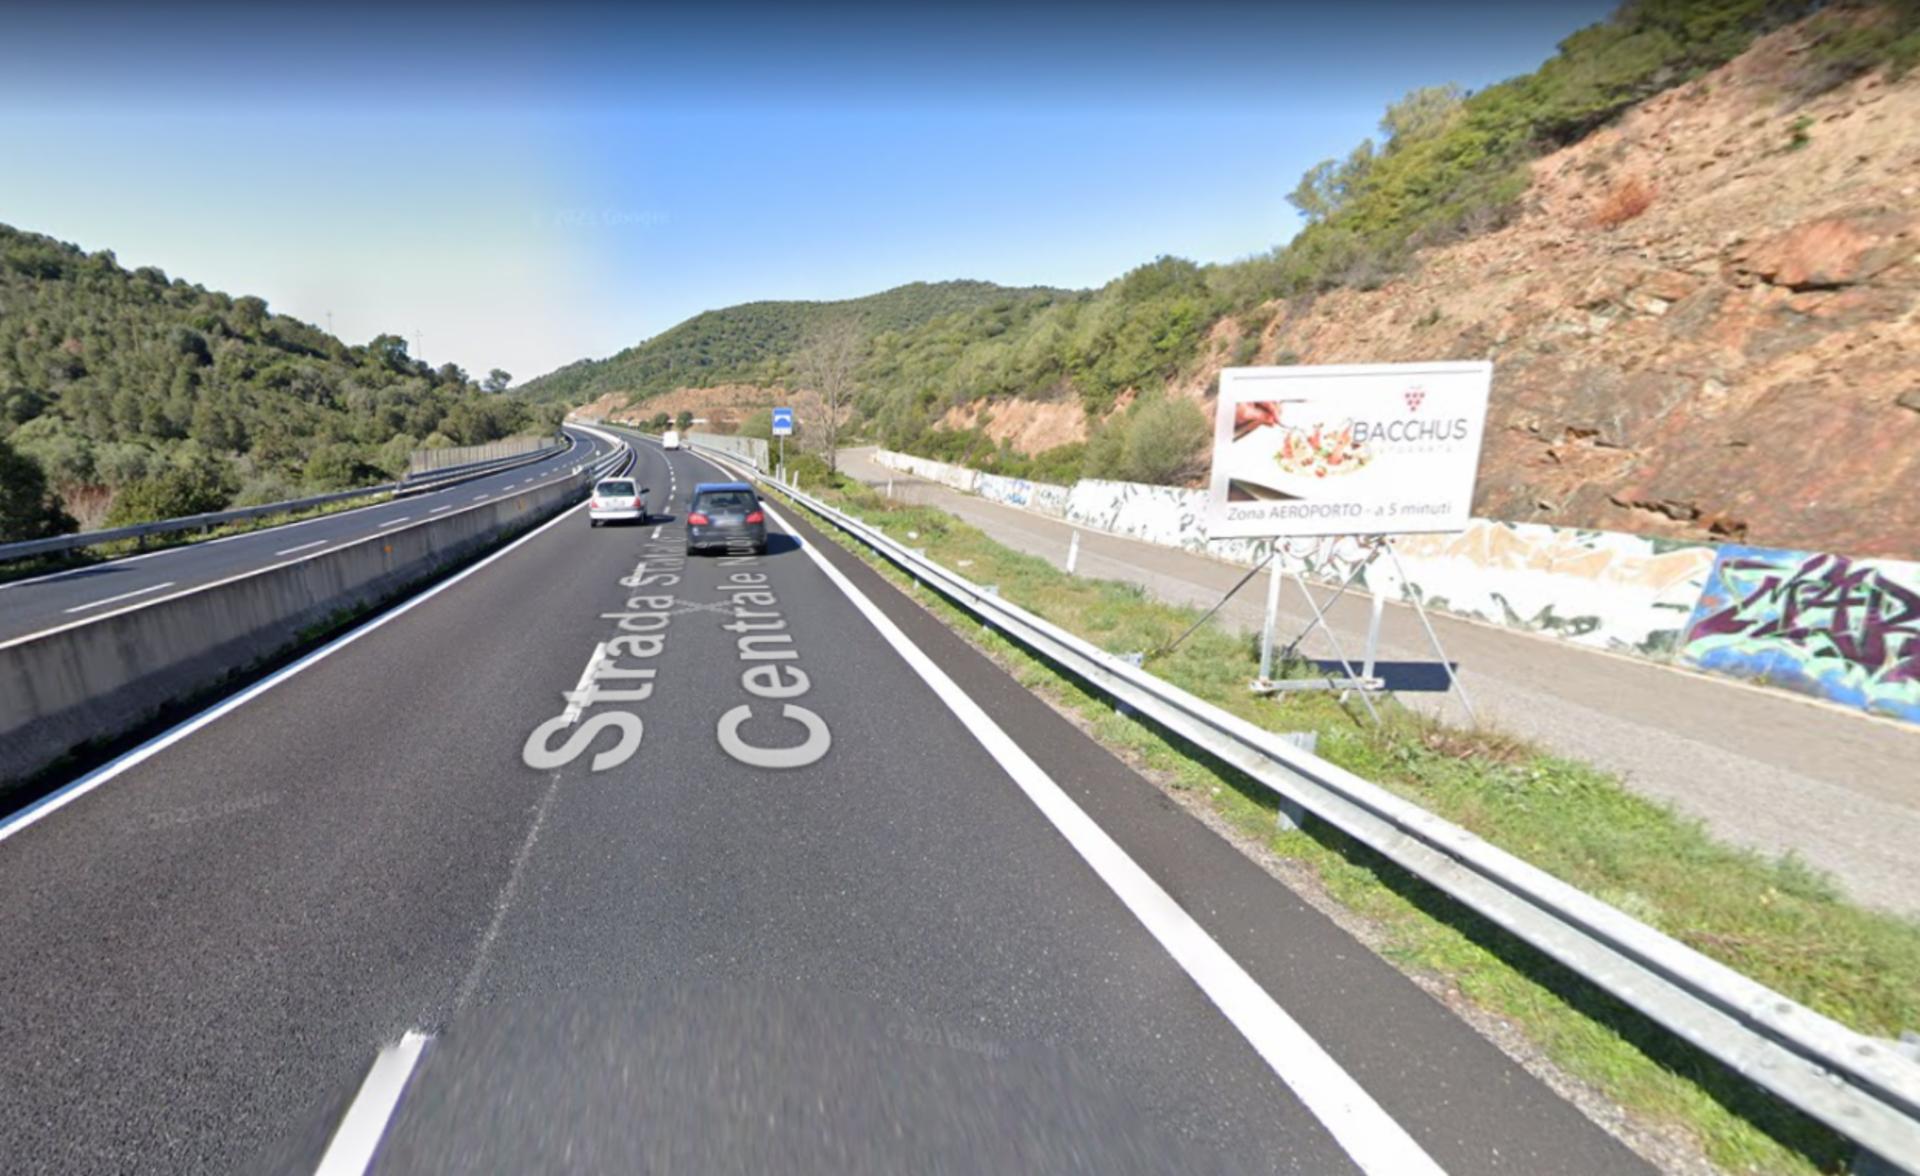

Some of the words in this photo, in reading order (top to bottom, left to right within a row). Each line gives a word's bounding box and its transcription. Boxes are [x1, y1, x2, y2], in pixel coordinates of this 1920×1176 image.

[1353, 418, 1468, 442] BACCHUS
[1227, 507, 1265, 520] Zona
[1269, 503, 1362, 519] AEROPORTO
[1388, 503, 1398, 517] 5
[1401, 502, 1452, 516] minuti
